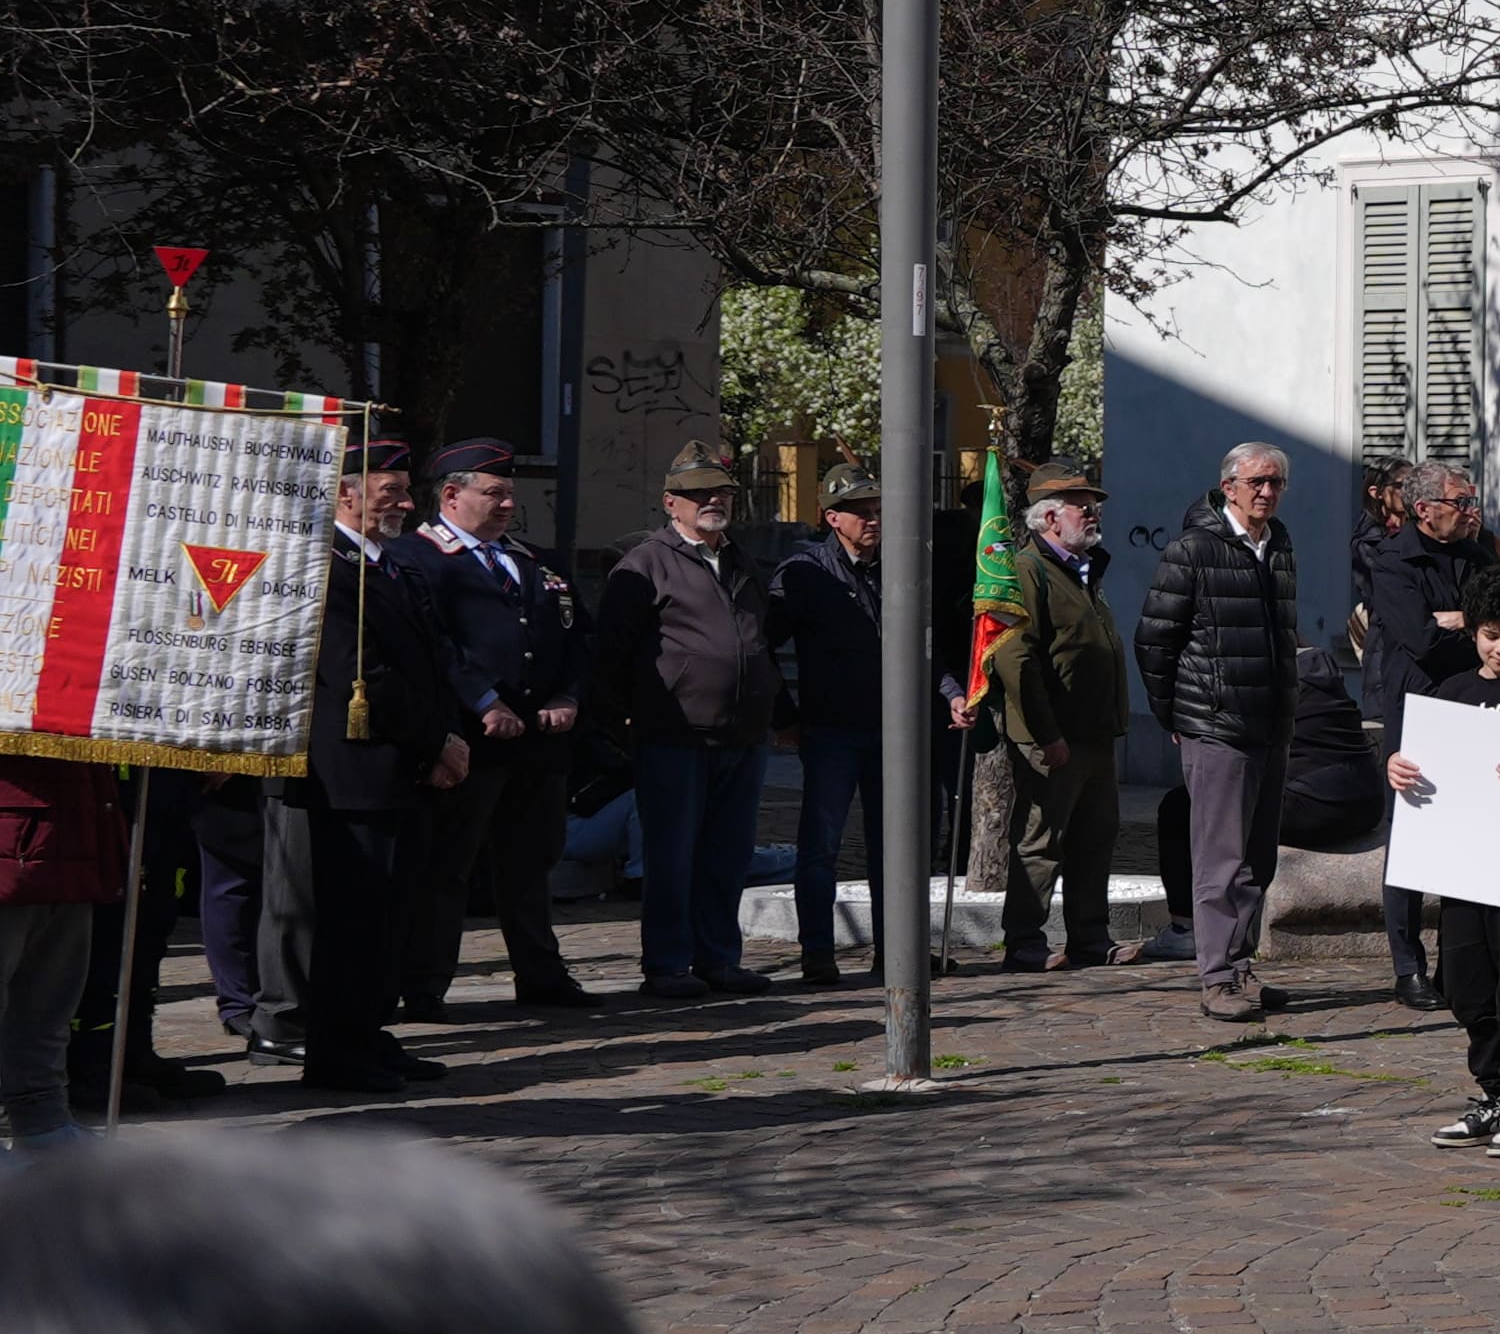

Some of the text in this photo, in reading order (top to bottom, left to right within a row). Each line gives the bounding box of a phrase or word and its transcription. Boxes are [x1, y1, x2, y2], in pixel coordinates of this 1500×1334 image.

[147, 429, 333, 465] MAUTHAUSEN BUCHENWALD
[142, 466, 221, 489] AUSCHWITZ
[4, 481, 113, 515] DEPORTATI
[147, 503, 313, 536] CASTELLO DI HARTHEIM
[66, 527, 97, 552] NEI
[27, 563, 103, 593] NAZISTI
[128, 567, 176, 585] MELK
[262, 581, 317, 599] DACHAU
[128, 629, 297, 658] FLOSSENBURG EBENSEE
[110, 665, 304, 695] GUSEN BOLZANO FOSSOLI
[110, 702, 293, 731] RISIERA DI SAN SABBA
